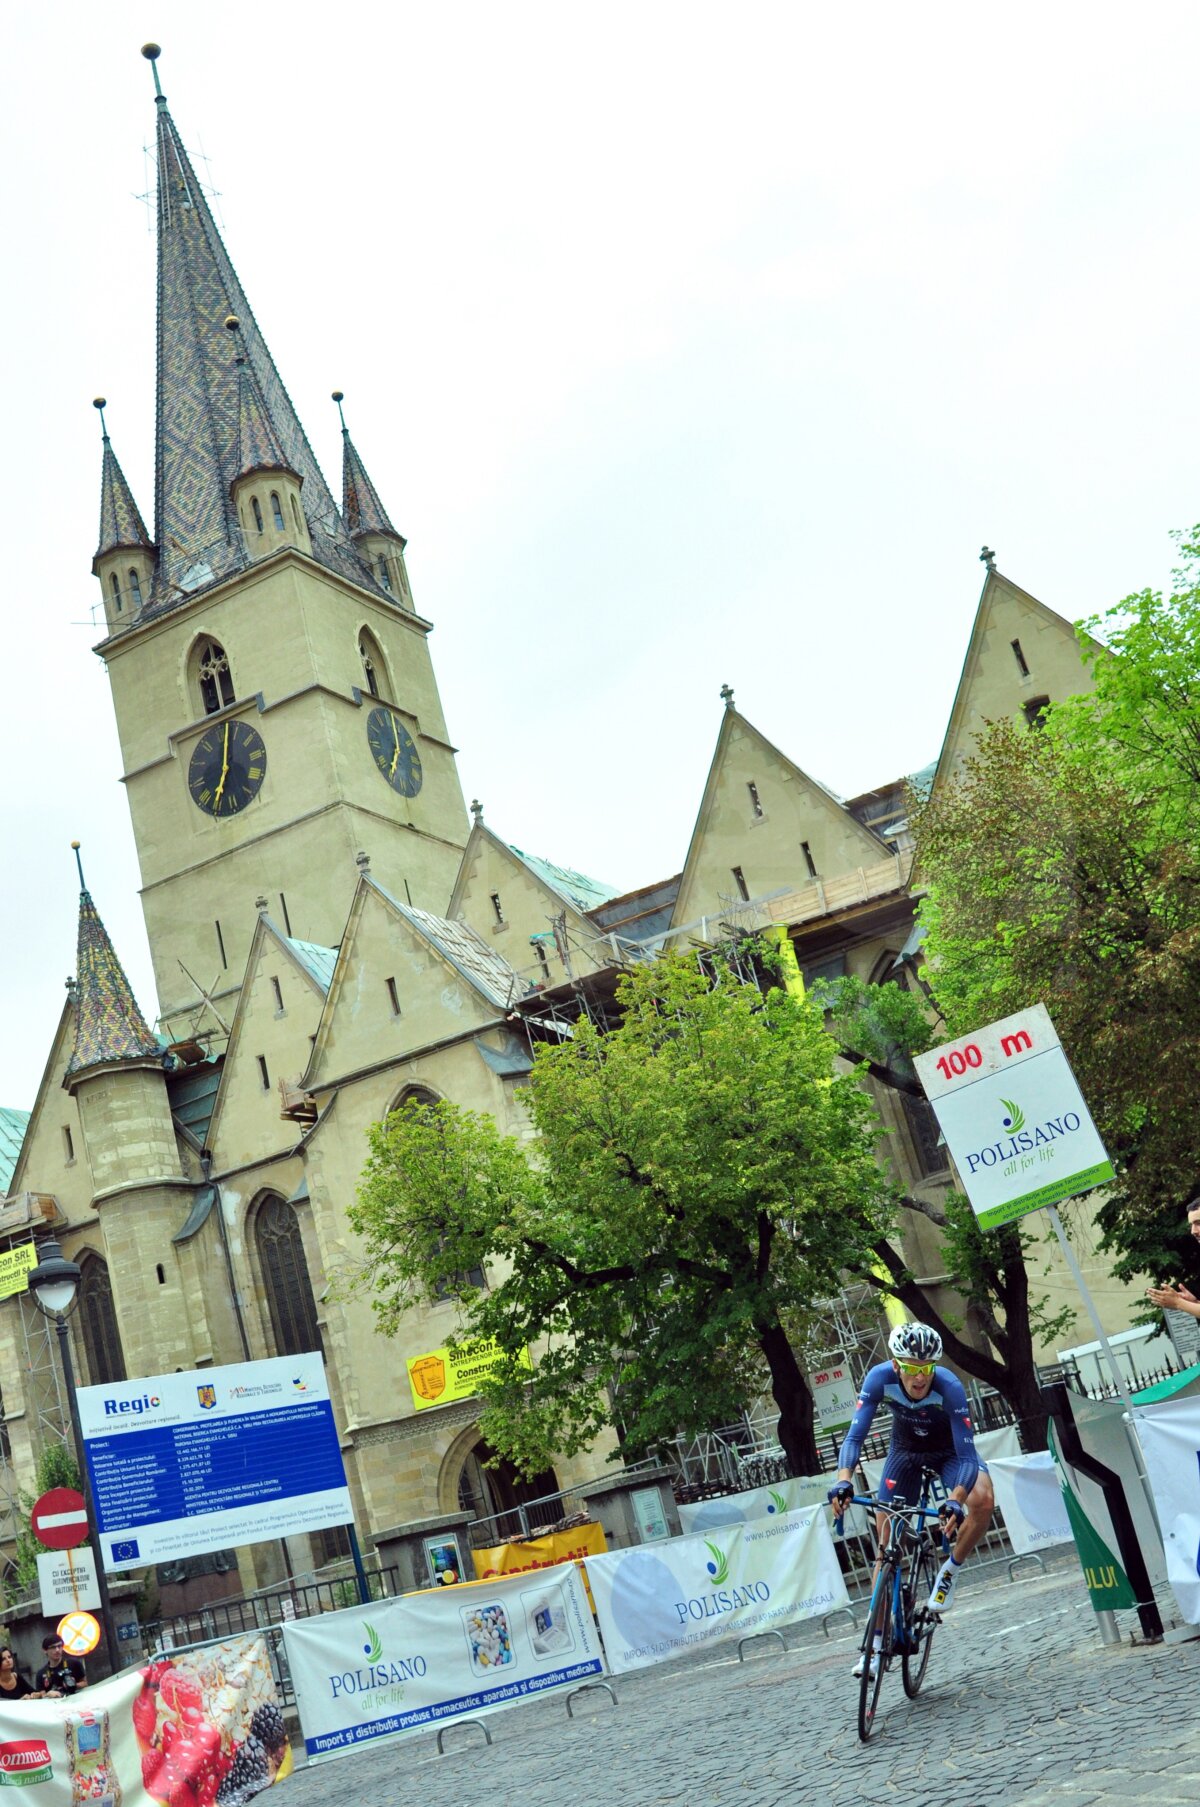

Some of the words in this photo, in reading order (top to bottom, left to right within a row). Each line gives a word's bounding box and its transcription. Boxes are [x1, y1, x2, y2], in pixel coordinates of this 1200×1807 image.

[936, 1044, 983, 1080] 100
[1000, 1030, 1032, 1057] m
[965, 1112, 1081, 1174] POLISANO
[1003, 1157, 1018, 1178] all
[1020, 1152, 1037, 1175] for
[1038, 1143, 1056, 1166] life
[14, 1249, 31, 1262] SRL
[104, 1394, 160, 1414] Regio
[820, 1400, 855, 1415] POLISANO
[744, 1518, 811, 1543] www.polisano.ro
[674, 1581, 771, 1624] POLISANO
[329, 1655, 427, 1698] POLISANO
[315, 1731, 344, 1752] Import
[398, 1708, 430, 1728] produse
[527, 1670, 565, 1691] dispozitive
[565, 1661, 596, 1679] medicale
[361, 1693, 373, 1711] all
